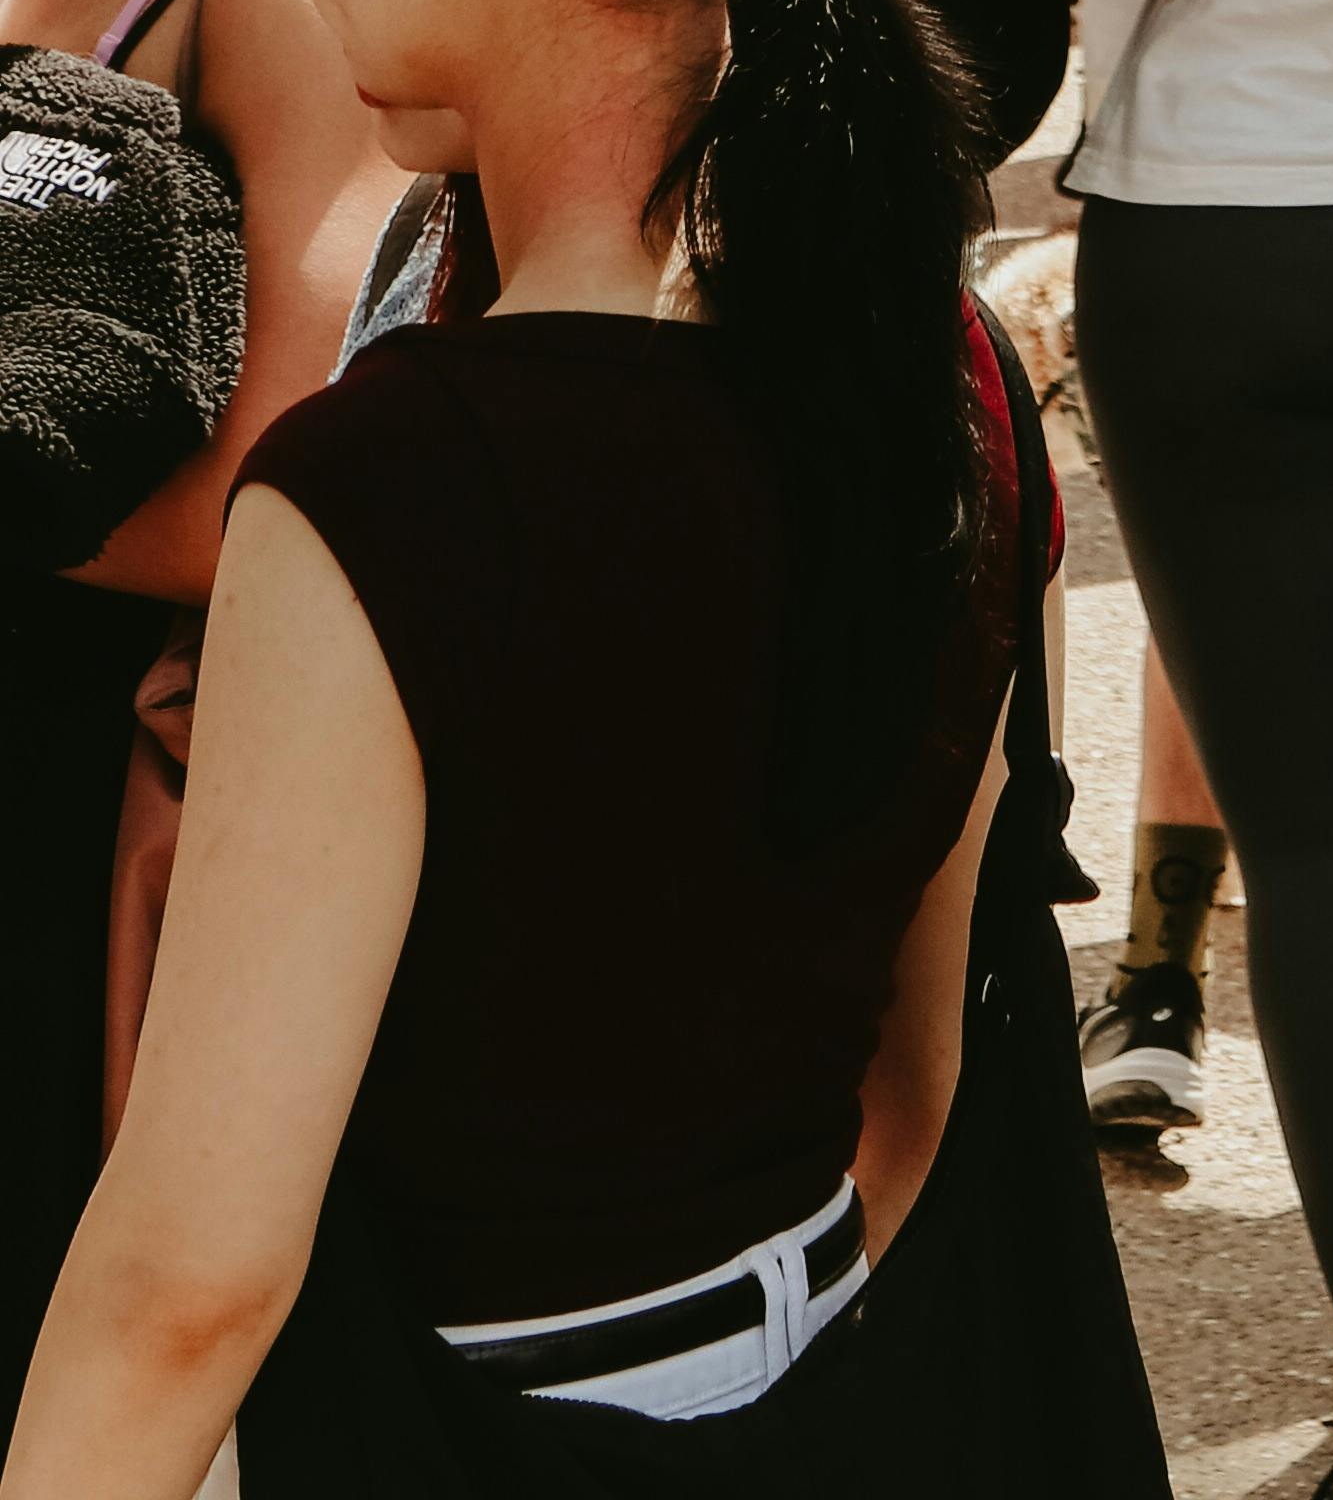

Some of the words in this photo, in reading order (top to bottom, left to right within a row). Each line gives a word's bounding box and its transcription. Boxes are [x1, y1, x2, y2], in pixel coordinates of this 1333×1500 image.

[36, 137, 112, 171] FACE
[0, 175, 55, 209] THE
[17, 155, 118, 202] NORTH
